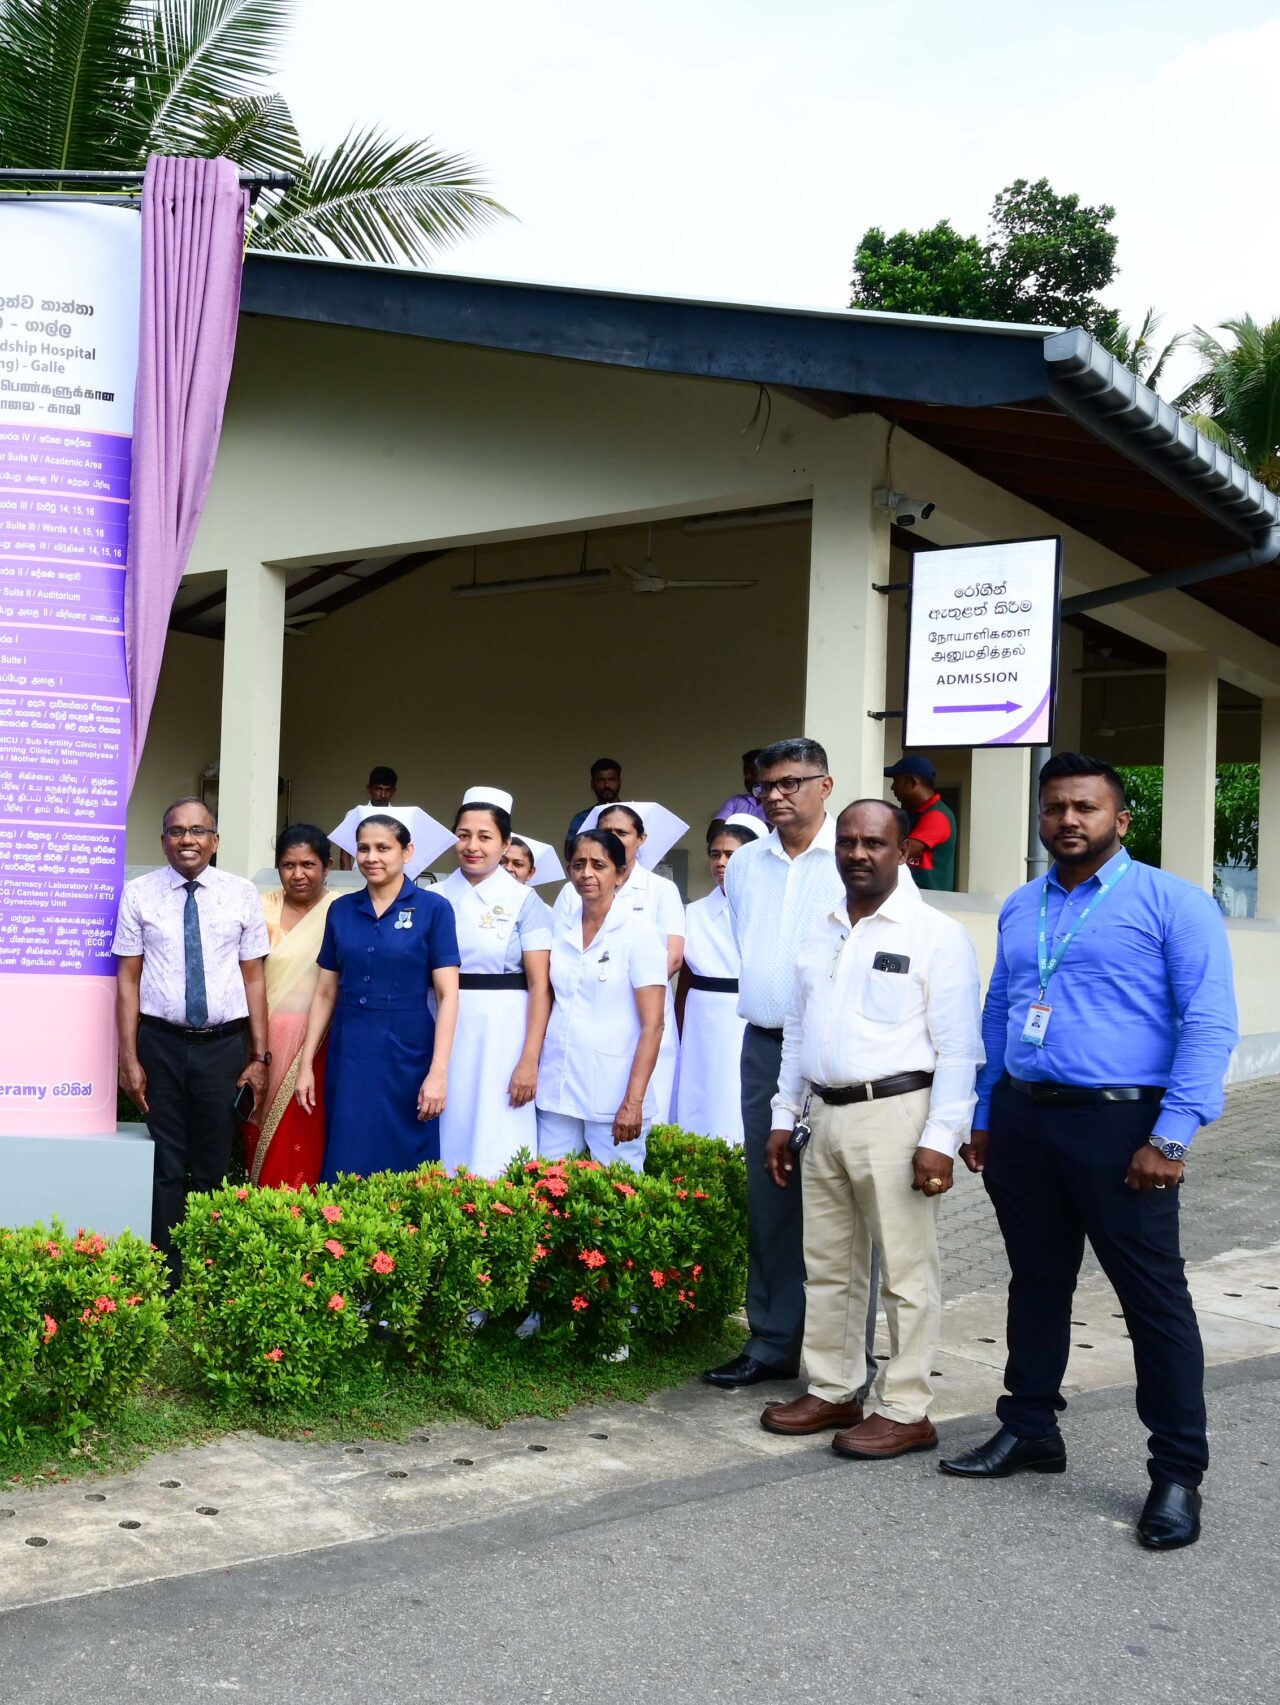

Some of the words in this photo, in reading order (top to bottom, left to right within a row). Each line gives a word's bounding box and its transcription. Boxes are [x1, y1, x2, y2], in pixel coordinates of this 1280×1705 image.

[41, 299, 94, 316] කාන්තා
[25, 320, 72, 338] ගාල්ල
[40, 343, 96, 360] Hospital
[31, 360, 65, 374] Galle
[47, 403, 81, 415] காலி
[8, 452, 29, 462] Suite
[30, 454, 38, 463] IV
[44, 456, 83, 467] Academic
[84, 460, 102, 470] Area
[6, 521, 26, 531] Suite
[28, 522, 36, 531] III
[42, 523, 67, 534] Wards
[3, 587, 24, 597] Suite
[26, 589, 31, 598] II
[37, 590, 81, 601] Auditorium
[928, 628, 1030, 645] நோயாளிகளை
[1, 655, 22, 665] Suite
[931, 644, 1026, 662] அனுமதித்தல்
[936, 672, 1018, 685] ADMISSION
[25, 737, 42, 745] Sub
[44, 739, 73, 748] Fertility
[75, 741, 97, 749] Clinic
[103, 742, 119, 751] Well
[29, 747, 52, 755] Clinic
[10, 755, 38, 763] Mother
[40, 756, 60, 766] Baby
[62, 757, 78, 765] Unit
[4, 879, 45, 889] Pharmacy
[48, 881, 89, 891] Laboratory
[93, 883, 115, 893] X-Ray
[16, 889, 48, 897] Canteen
[54, 891, 93, 899] Admission
[51, 899, 67, 907] Unit
[52, 1082, 92, 1097] වෙතින්
